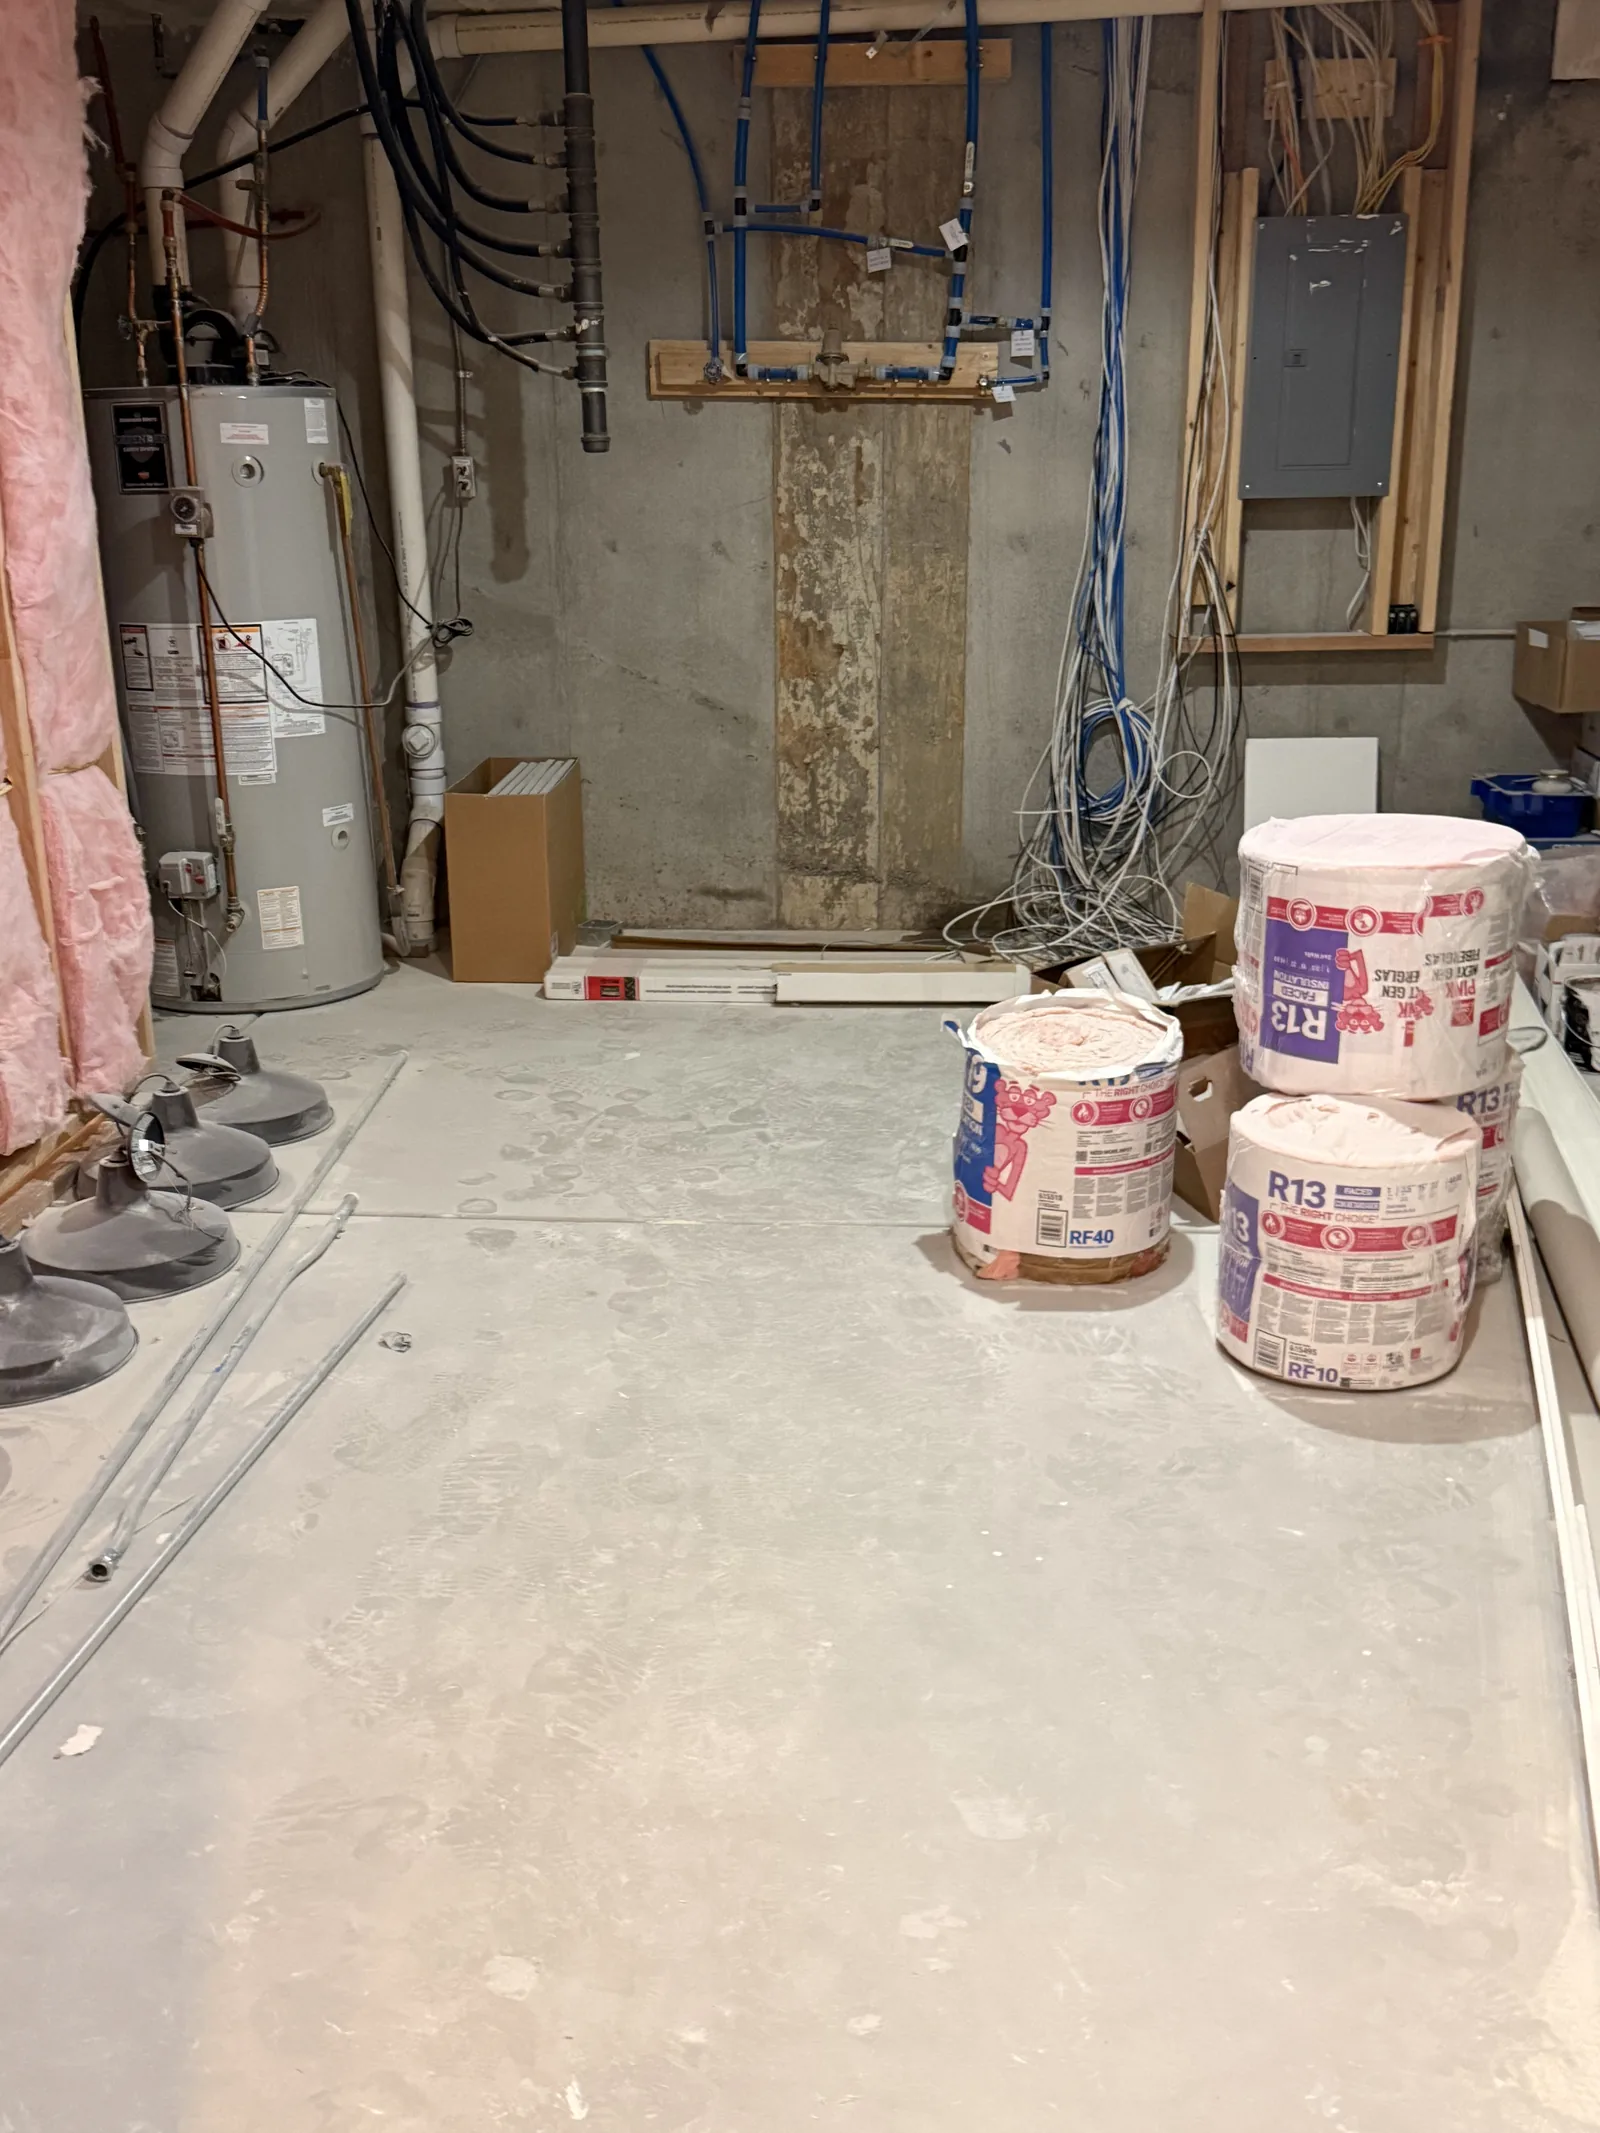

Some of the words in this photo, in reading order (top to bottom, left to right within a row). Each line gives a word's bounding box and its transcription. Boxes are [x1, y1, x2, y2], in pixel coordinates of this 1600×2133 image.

[1273, 968, 1330, 990] INSULATION
[1374, 969, 1420, 983] ERGLAS
[1280, 985, 1316, 1002] FACED
[1381, 985, 1406, 999] GEN
[1271, 1001, 1327, 1041] R13
[1114, 1085, 1139, 1097] RIGHT
[1456, 1086, 1501, 1116] R13
[1268, 1170, 1327, 1209] R13
[1343, 1186, 1374, 1196] FACED
[1279, 1202, 1301, 1215] THE
[1300, 1206, 1334, 1221] RIGHT
[1335, 1211, 1379, 1225] CHOICE
[1069, 1229, 1115, 1246] RF40
[1287, 1361, 1339, 1383] RF10
